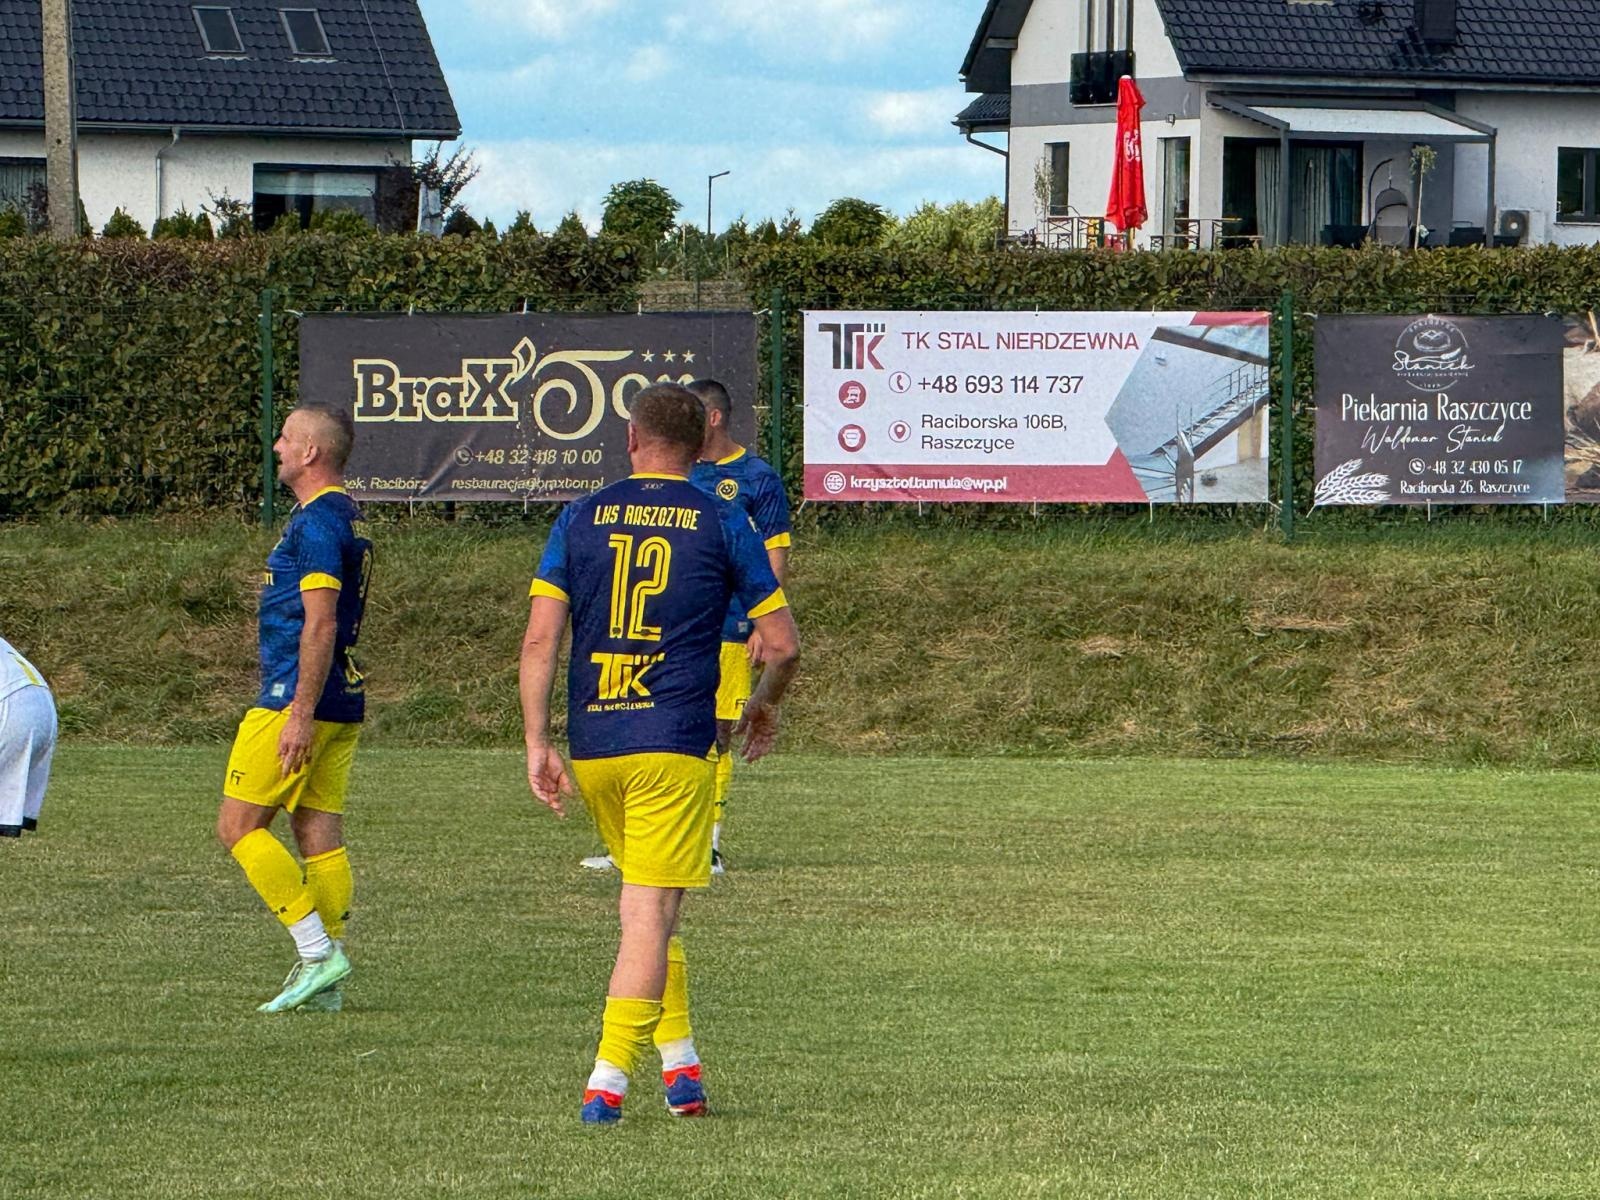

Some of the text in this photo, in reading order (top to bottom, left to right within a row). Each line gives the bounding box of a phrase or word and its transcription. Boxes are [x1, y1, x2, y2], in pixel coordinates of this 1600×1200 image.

[902, 332, 1139, 350] TK STAL NIERDZEWNA
[917, 375, 1084, 394] +48 693 114 737
[1342, 393, 1532, 427] Piekarnia Raszczyce
[921, 414, 1067, 431] Raciborska 106B,
[921, 435, 1015, 453] Raszczyce
[475, 450, 504, 465] +48
[509, 450, 528, 465] 32
[562, 450, 577, 465] 10
[581, 450, 602, 465] 00
[1451, 460, 1464, 474] 32
[1469, 460, 1490, 474] 430
[1494, 460, 1508, 474] 05
[1513, 460, 1522, 474] 17
[1401, 480, 1454, 494] Raciborska
[608, 533, 672, 641] 12
